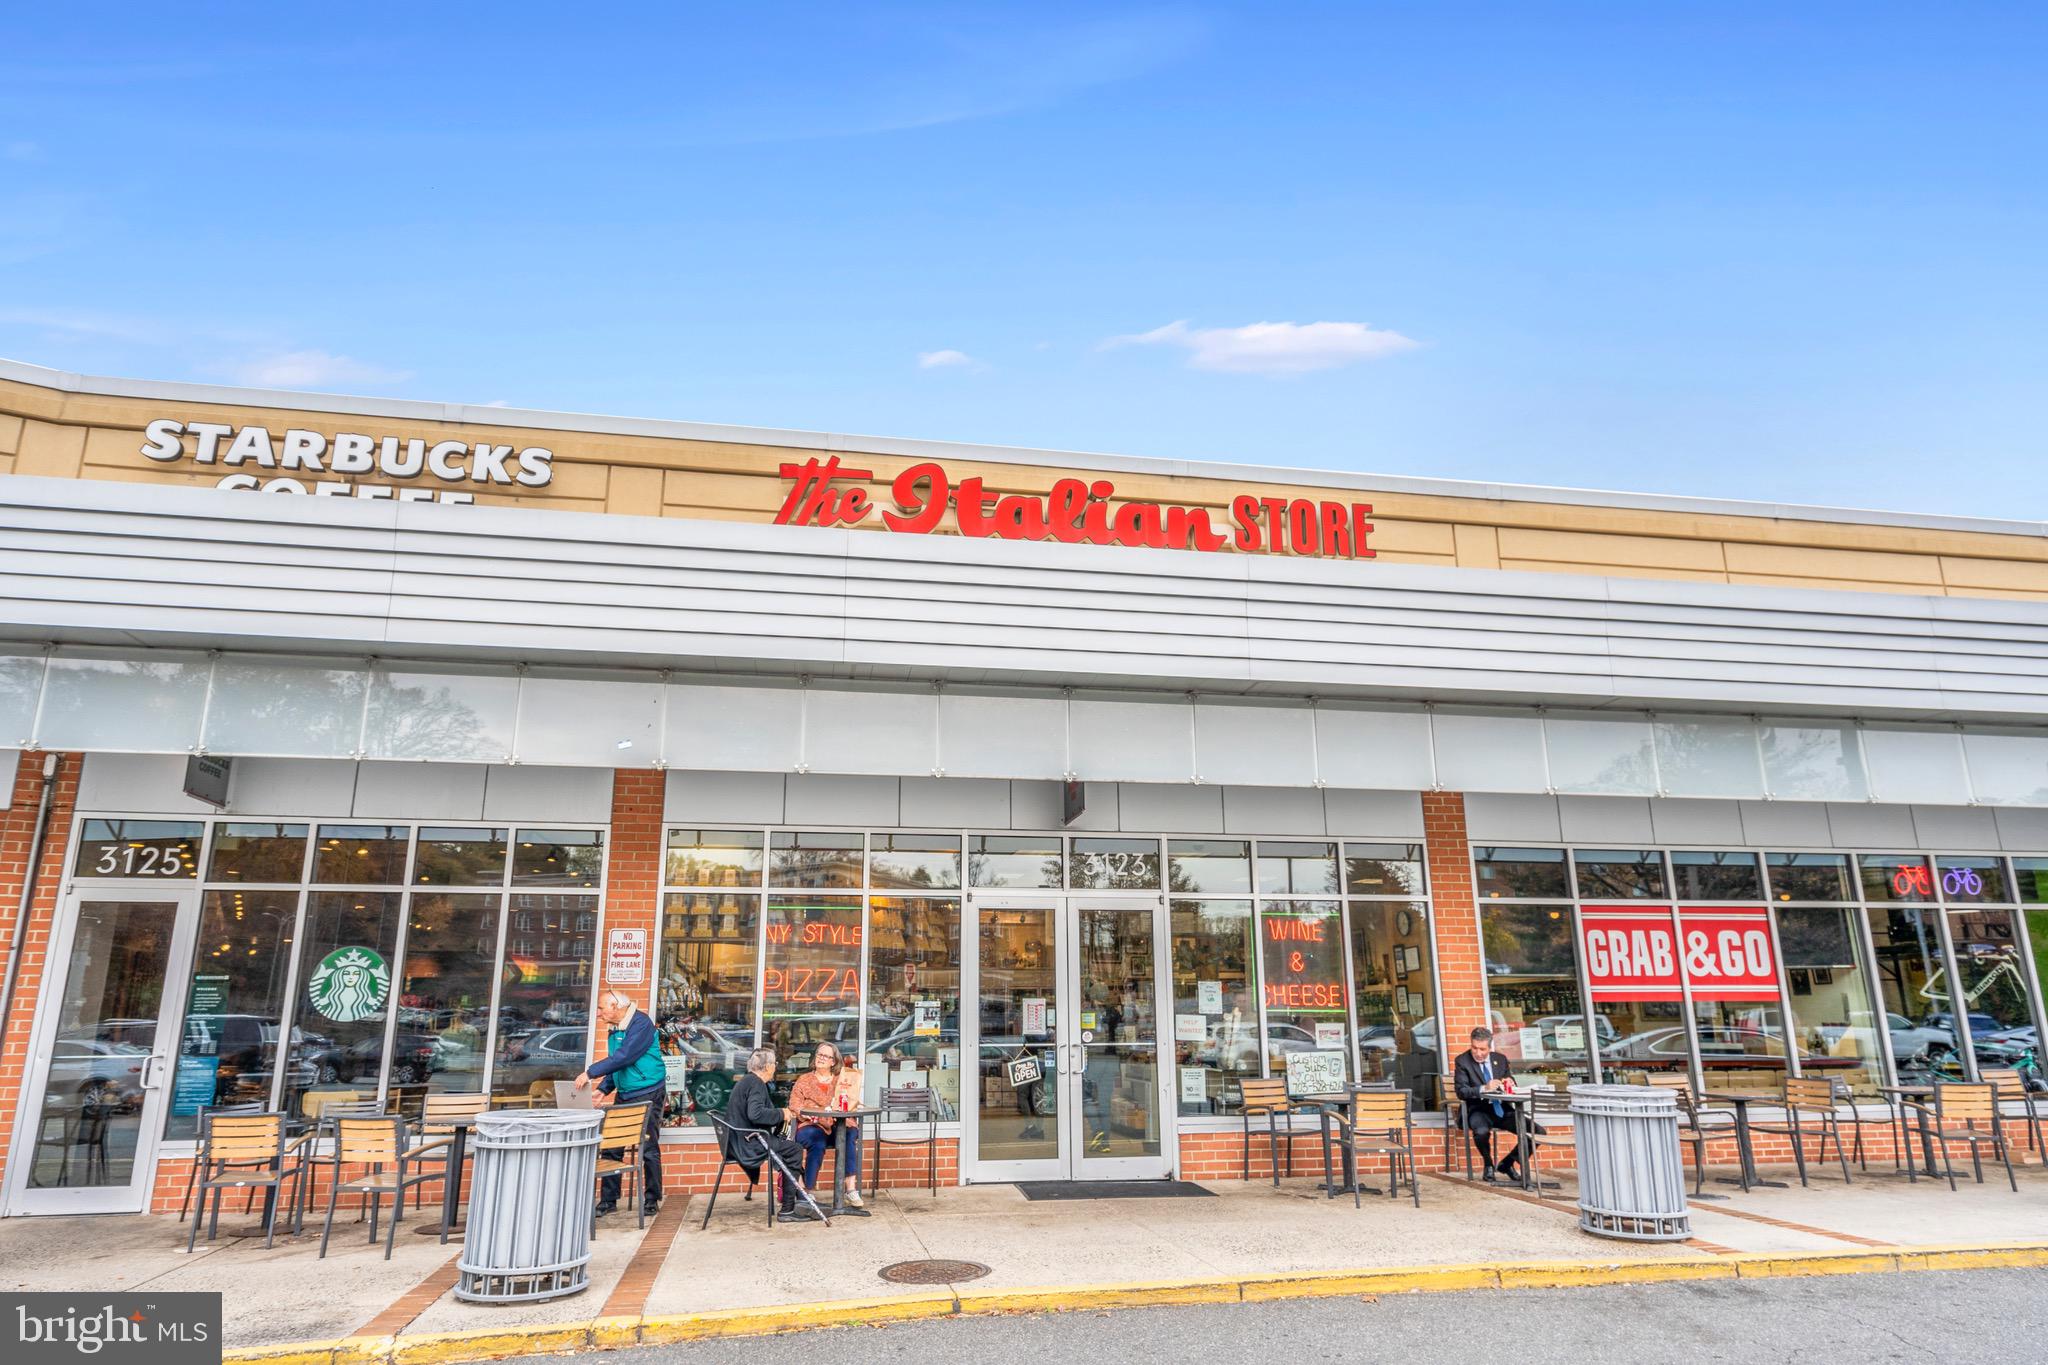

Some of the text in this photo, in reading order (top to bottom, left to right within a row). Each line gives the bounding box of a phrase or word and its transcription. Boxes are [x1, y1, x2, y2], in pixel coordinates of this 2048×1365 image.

[140, 418, 553, 488] STARBUCKS
[773, 455, 1377, 559] The Italian STORE
[96, 846, 181, 875] 3125
[1083, 852, 1146, 876] 3123
[623, 932, 633, 941] NO
[766, 923, 862, 945] NY STYLE
[1268, 918, 1324, 942] WINE
[612, 942, 642, 950] PARKING
[1586, 929, 1674, 977] GRAB
[611, 961, 641, 969] FIRE LANE
[1291, 951, 1304, 972] &
[763, 968, 860, 1001] PIZZA
[1974, 964, 2006, 995] Bianchi
[1264, 984, 1340, 1007] CHEESE
[1014, 1068, 1037, 1082] OPEN
